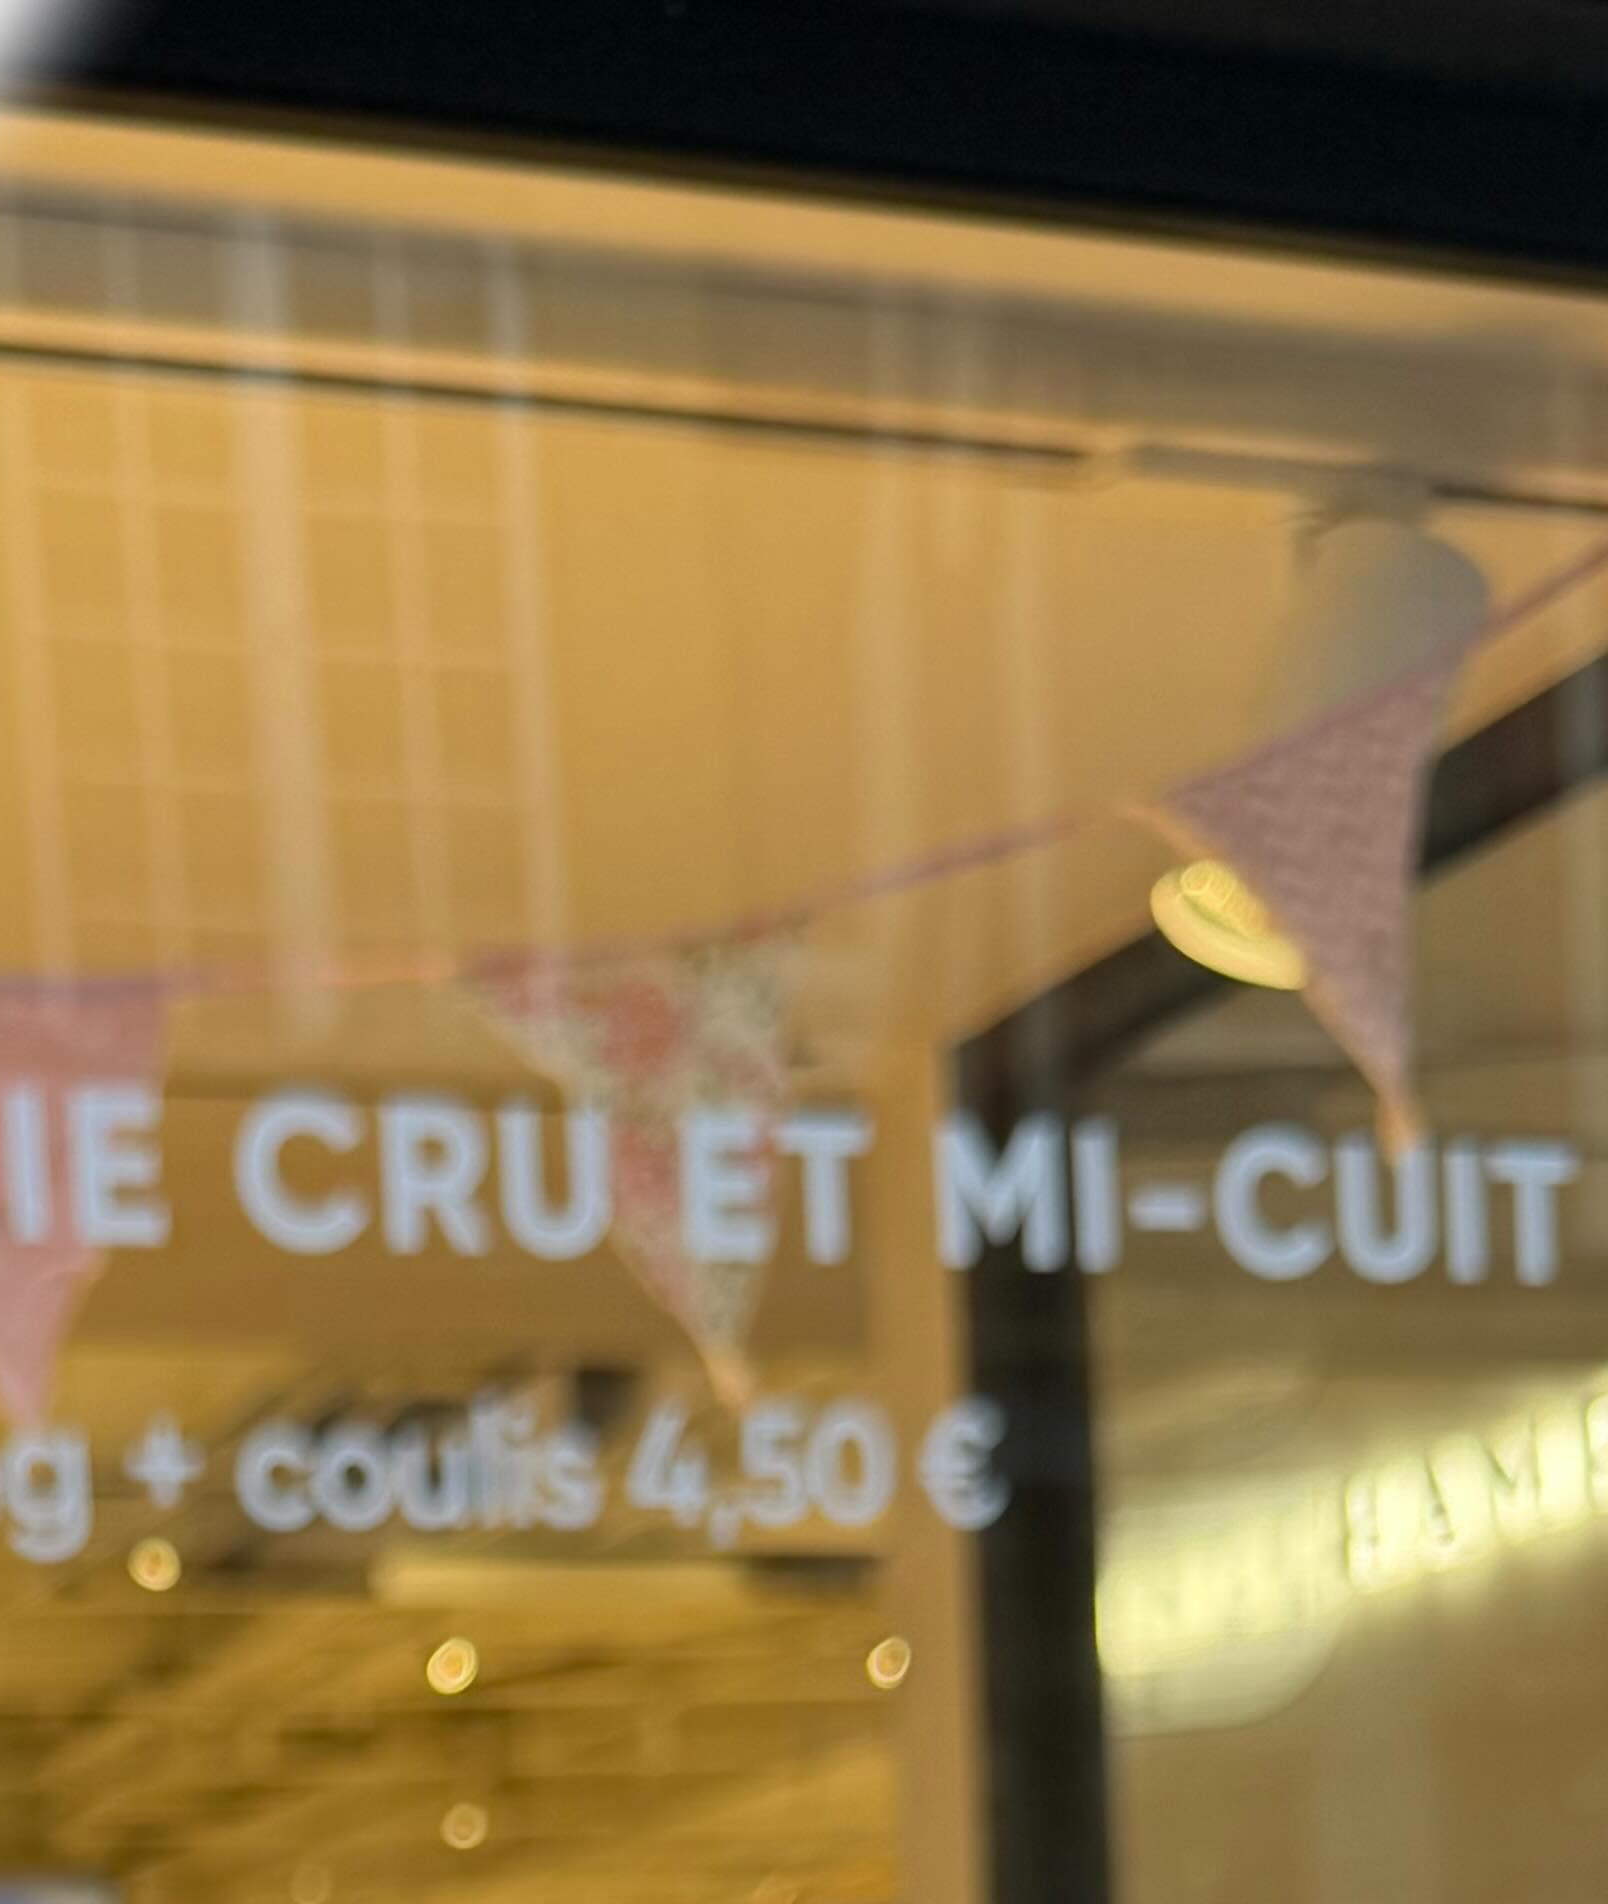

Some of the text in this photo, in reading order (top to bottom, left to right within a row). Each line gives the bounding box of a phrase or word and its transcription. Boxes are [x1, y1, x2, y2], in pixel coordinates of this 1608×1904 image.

[234, 1088, 612, 1258] CRU
[678, 1102, 872, 1264] ET
[934, 1110, 1578, 1284] MI-CUIT
[126, 1416, 202, 1505] +
[235, 1398, 600, 1531] coulis
[625, 1402, 893, 1545] 4,50
[920, 1399, 1006, 1528] €
